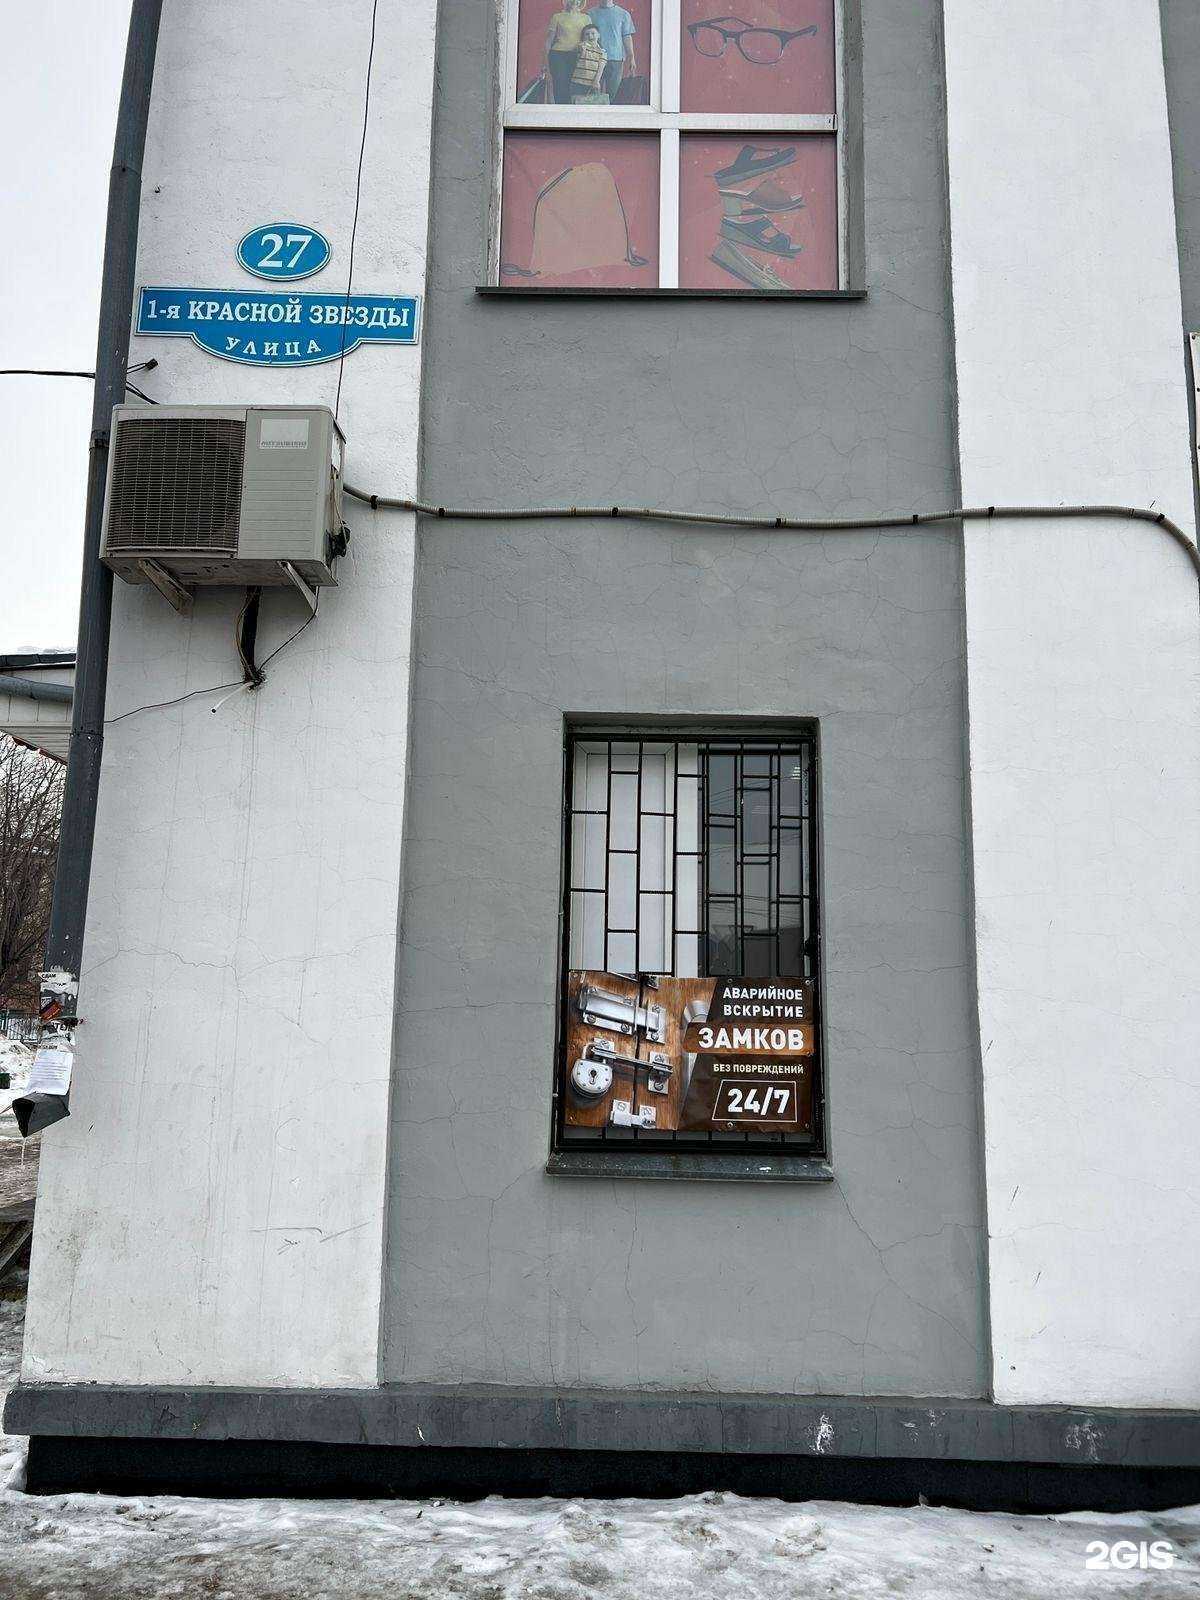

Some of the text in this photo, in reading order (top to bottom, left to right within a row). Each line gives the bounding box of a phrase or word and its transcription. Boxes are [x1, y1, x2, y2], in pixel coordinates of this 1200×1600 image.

[258, 233, 312, 268] 27
[147, 298, 410, 328] 1-я КРАСНОЙ ЗВЕЗДЫ
[225, 336, 322, 356] УЛИЦА
[722, 986, 803, 1001] АВАРИЙНОЕ
[723, 1004, 803, 1018] ВСКРЫТИЕ
[698, 1027, 804, 1050] ЗАМКОВ
[713, 1063, 804, 1075] БЕЗ ПОВРЕЖДЕНИЙ
[727, 1087, 790, 1116] 24/7
